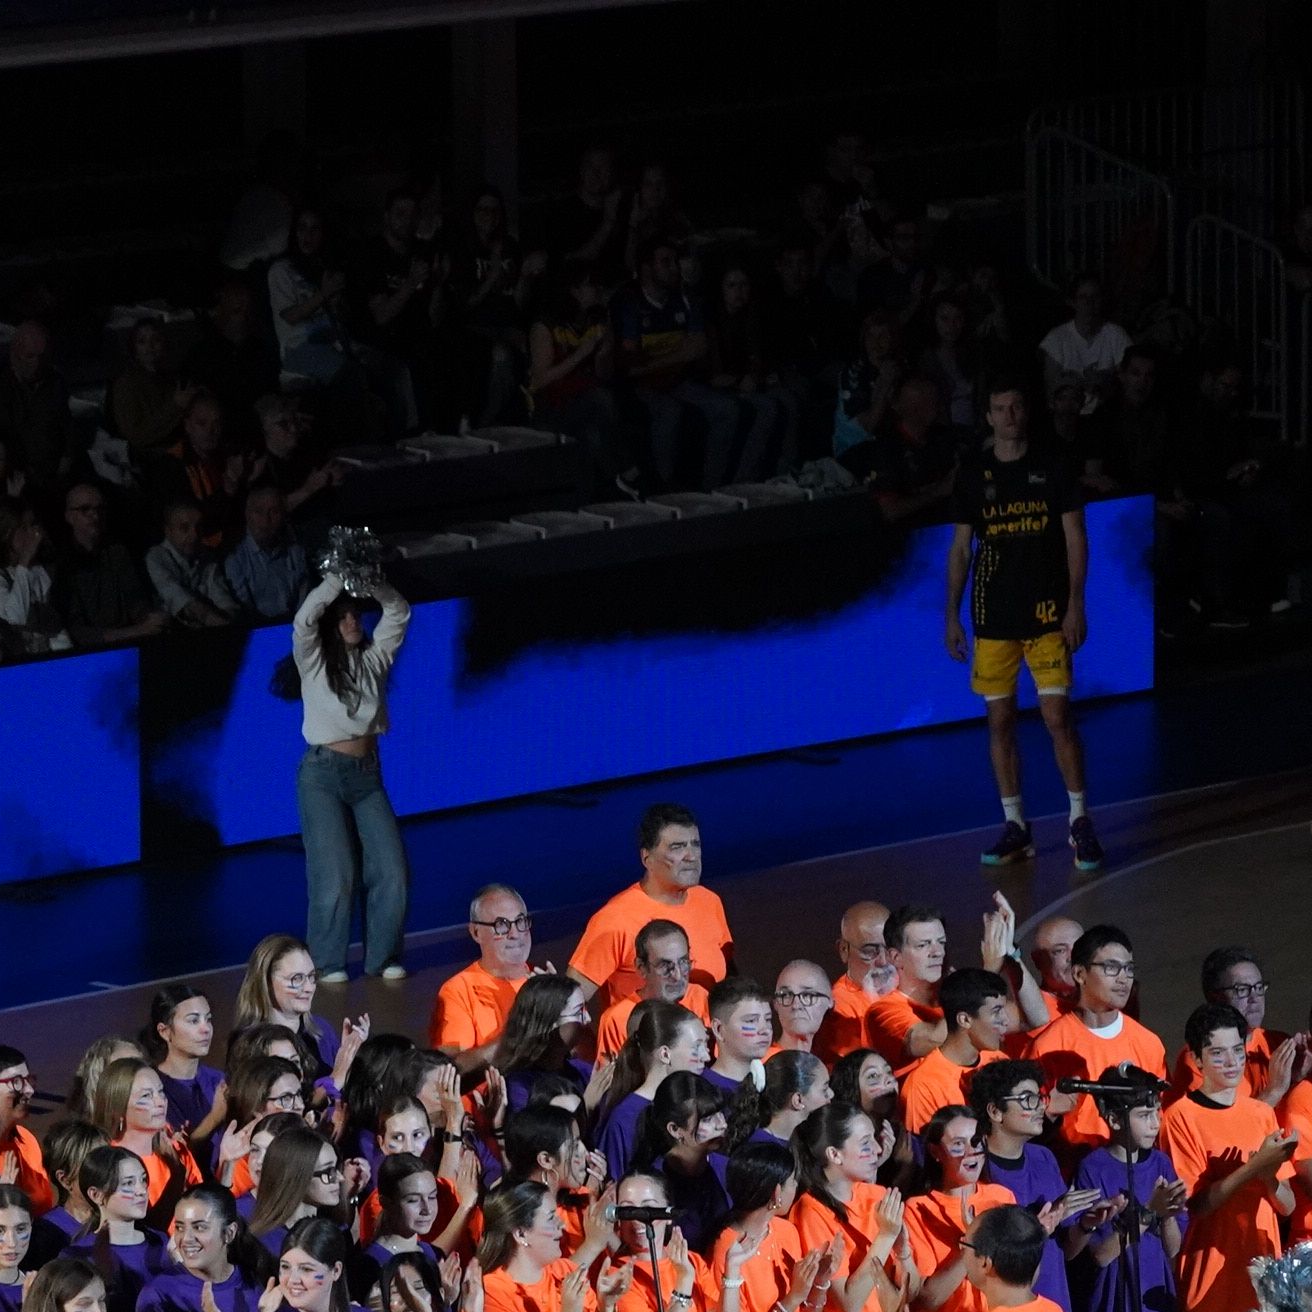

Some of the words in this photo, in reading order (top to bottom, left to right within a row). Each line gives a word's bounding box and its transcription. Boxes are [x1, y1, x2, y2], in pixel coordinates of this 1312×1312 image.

[982, 505, 997, 519] LA
[999, 500, 1048, 517] LAGUNA
[1035, 600, 1058, 625] 42
